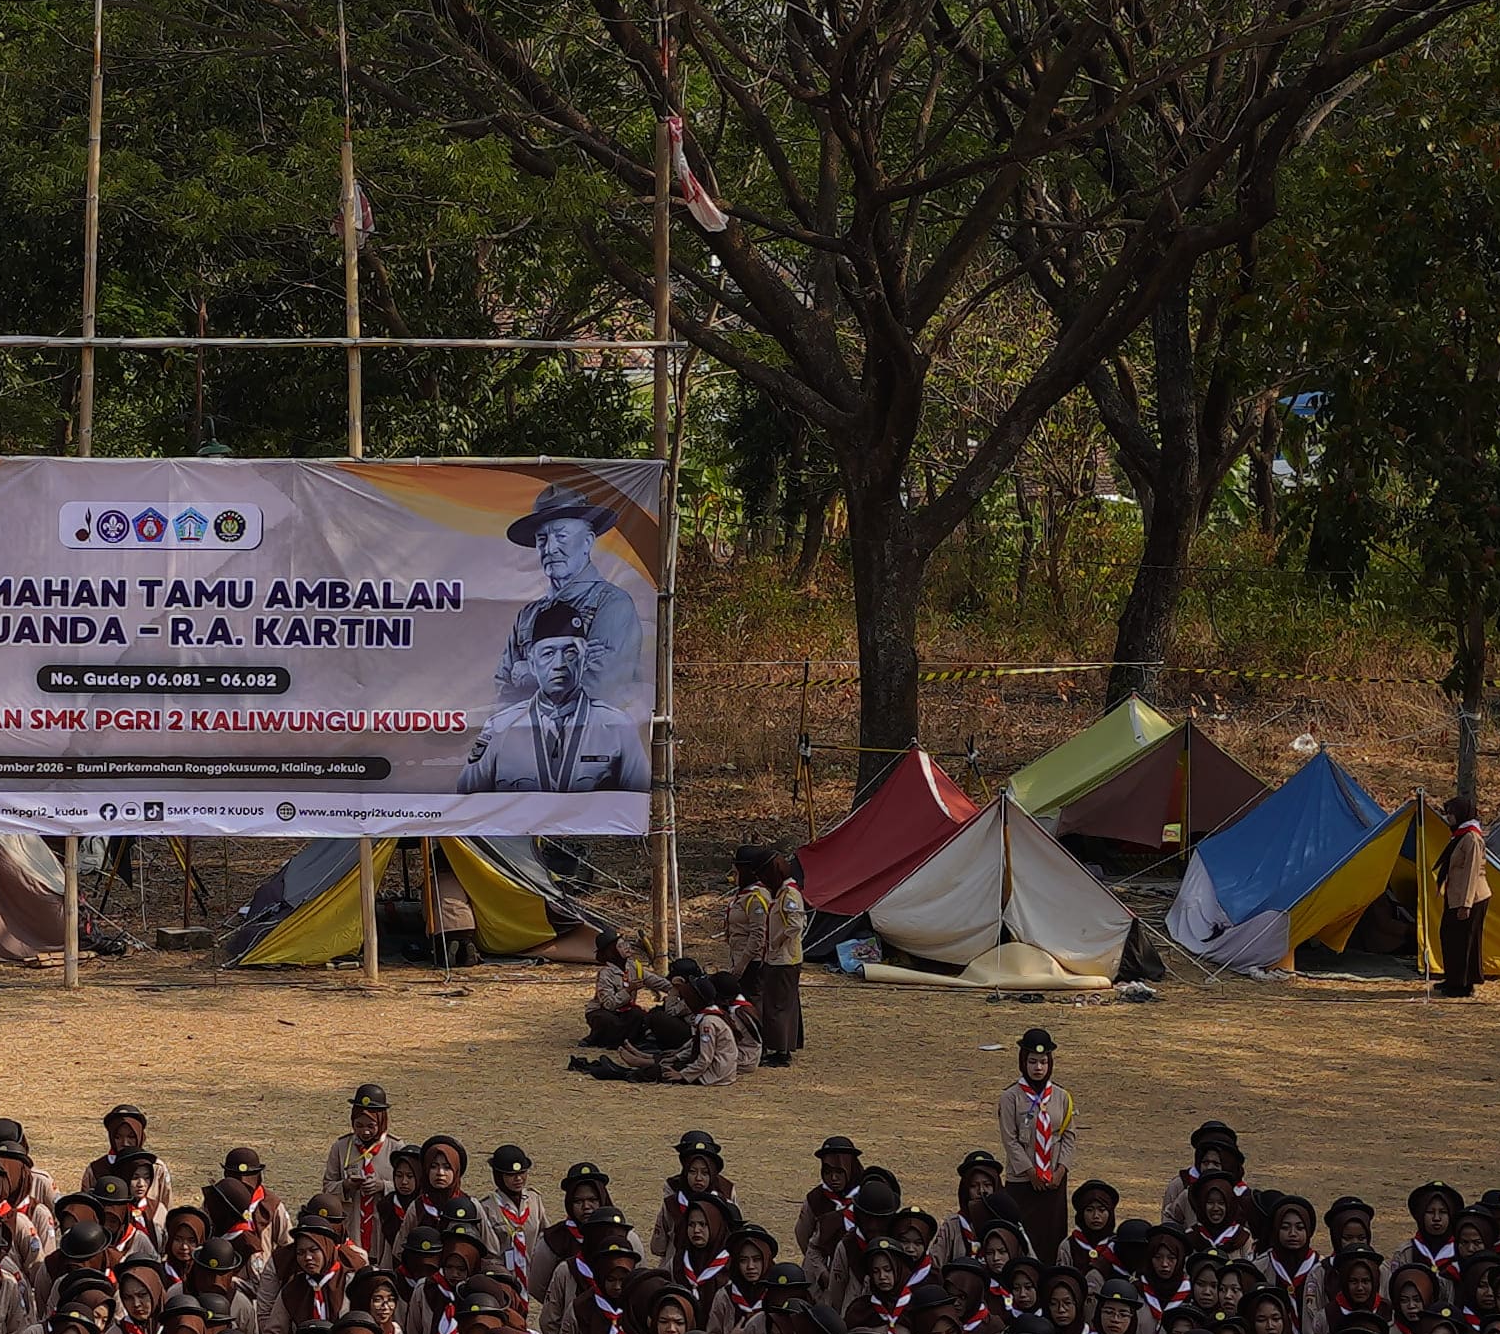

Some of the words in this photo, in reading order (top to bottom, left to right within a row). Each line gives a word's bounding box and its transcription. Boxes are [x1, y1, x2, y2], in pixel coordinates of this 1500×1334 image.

[138, 579, 255, 608] TAMU
[265, 581, 462, 610] AMBALAN
[170, 617, 244, 646] R.A.
[254, 618, 411, 646] KARTINI
[50, 672, 79, 686] No.
[84, 672, 142, 689] Gudep
[146, 673, 201, 686] 06.081
[220, 673, 277, 687] 06.082
[30, 709, 87, 730] SMK
[96, 710, 160, 730] PGRI
[168, 710, 183, 731] 2
[191, 711, 364, 732] KALIWUNGU
[374, 712, 467, 732] KUDUS
[77, 762, 107, 772] Bumi
[108, 762, 183, 772] Perkemahan
[185, 763, 280, 775] Ronggokusuma,
[281, 762, 325, 775] Klaling,
[327, 762, 366, 773] Jekulo
[167, 807, 192, 816] SMK
[192, 806, 217, 816] PGRI
[219, 806, 226, 816] 2
[228, 806, 265, 816] KUDUS
[298, 808, 442, 820] www.smkpgri2kudus.com
